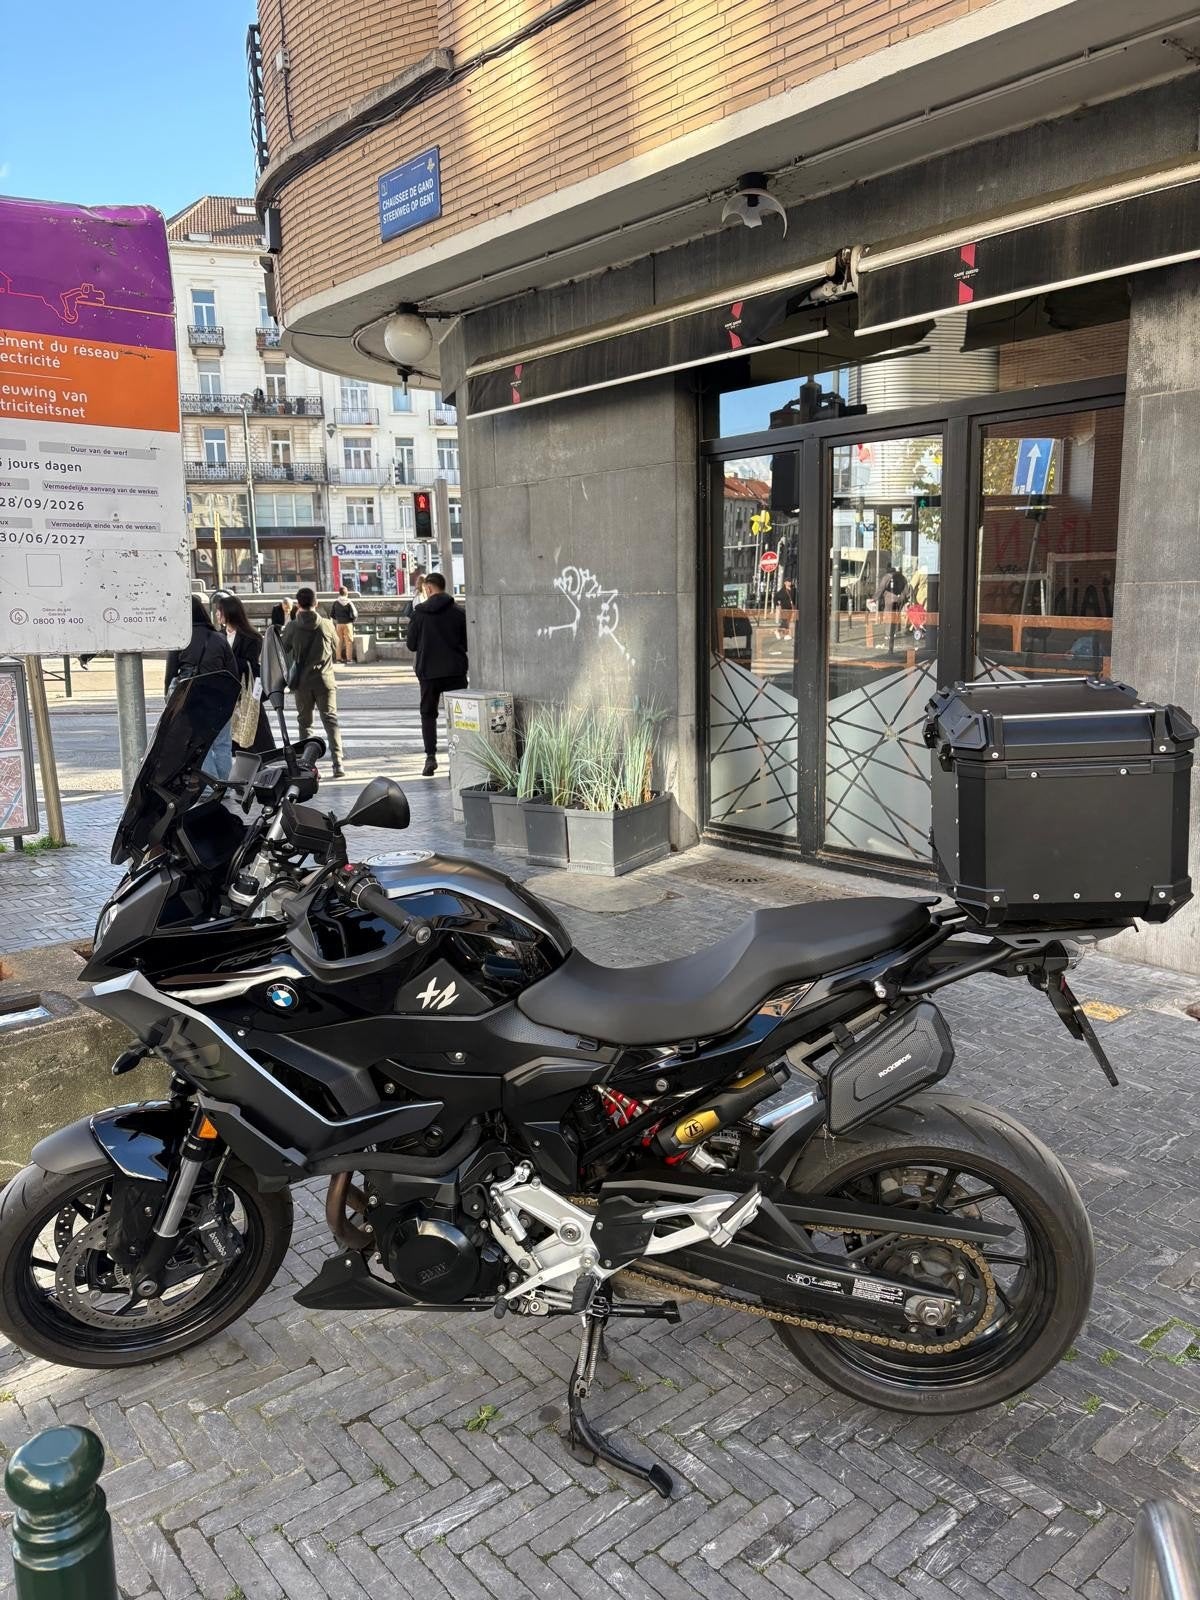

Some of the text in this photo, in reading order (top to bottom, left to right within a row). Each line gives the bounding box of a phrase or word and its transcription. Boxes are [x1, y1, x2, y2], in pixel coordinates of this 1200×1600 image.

[382, 178, 434, 210] CHAUSSEE DE GAND
[382, 191, 435, 224] STEENWEG OP GENT
[50, 341, 67, 353] du
[74, 345, 119, 360] réseau
[2, 384, 88, 403] euwing van
[0, 398, 86, 418] triciteitsnet
[8, 458, 40, 470] jours
[45, 461, 82, 474] dagen
[44, 483, 88, 492] Vermoedelijke
[0, 497, 84, 511] 28/09/2026
[0, 532, 85, 545] 30/06/2027
[878, 1053, 912, 1078] ROCKBROS
[685, 1123, 704, 1137] ZF
[209, 1231, 227, 1257] brembo
